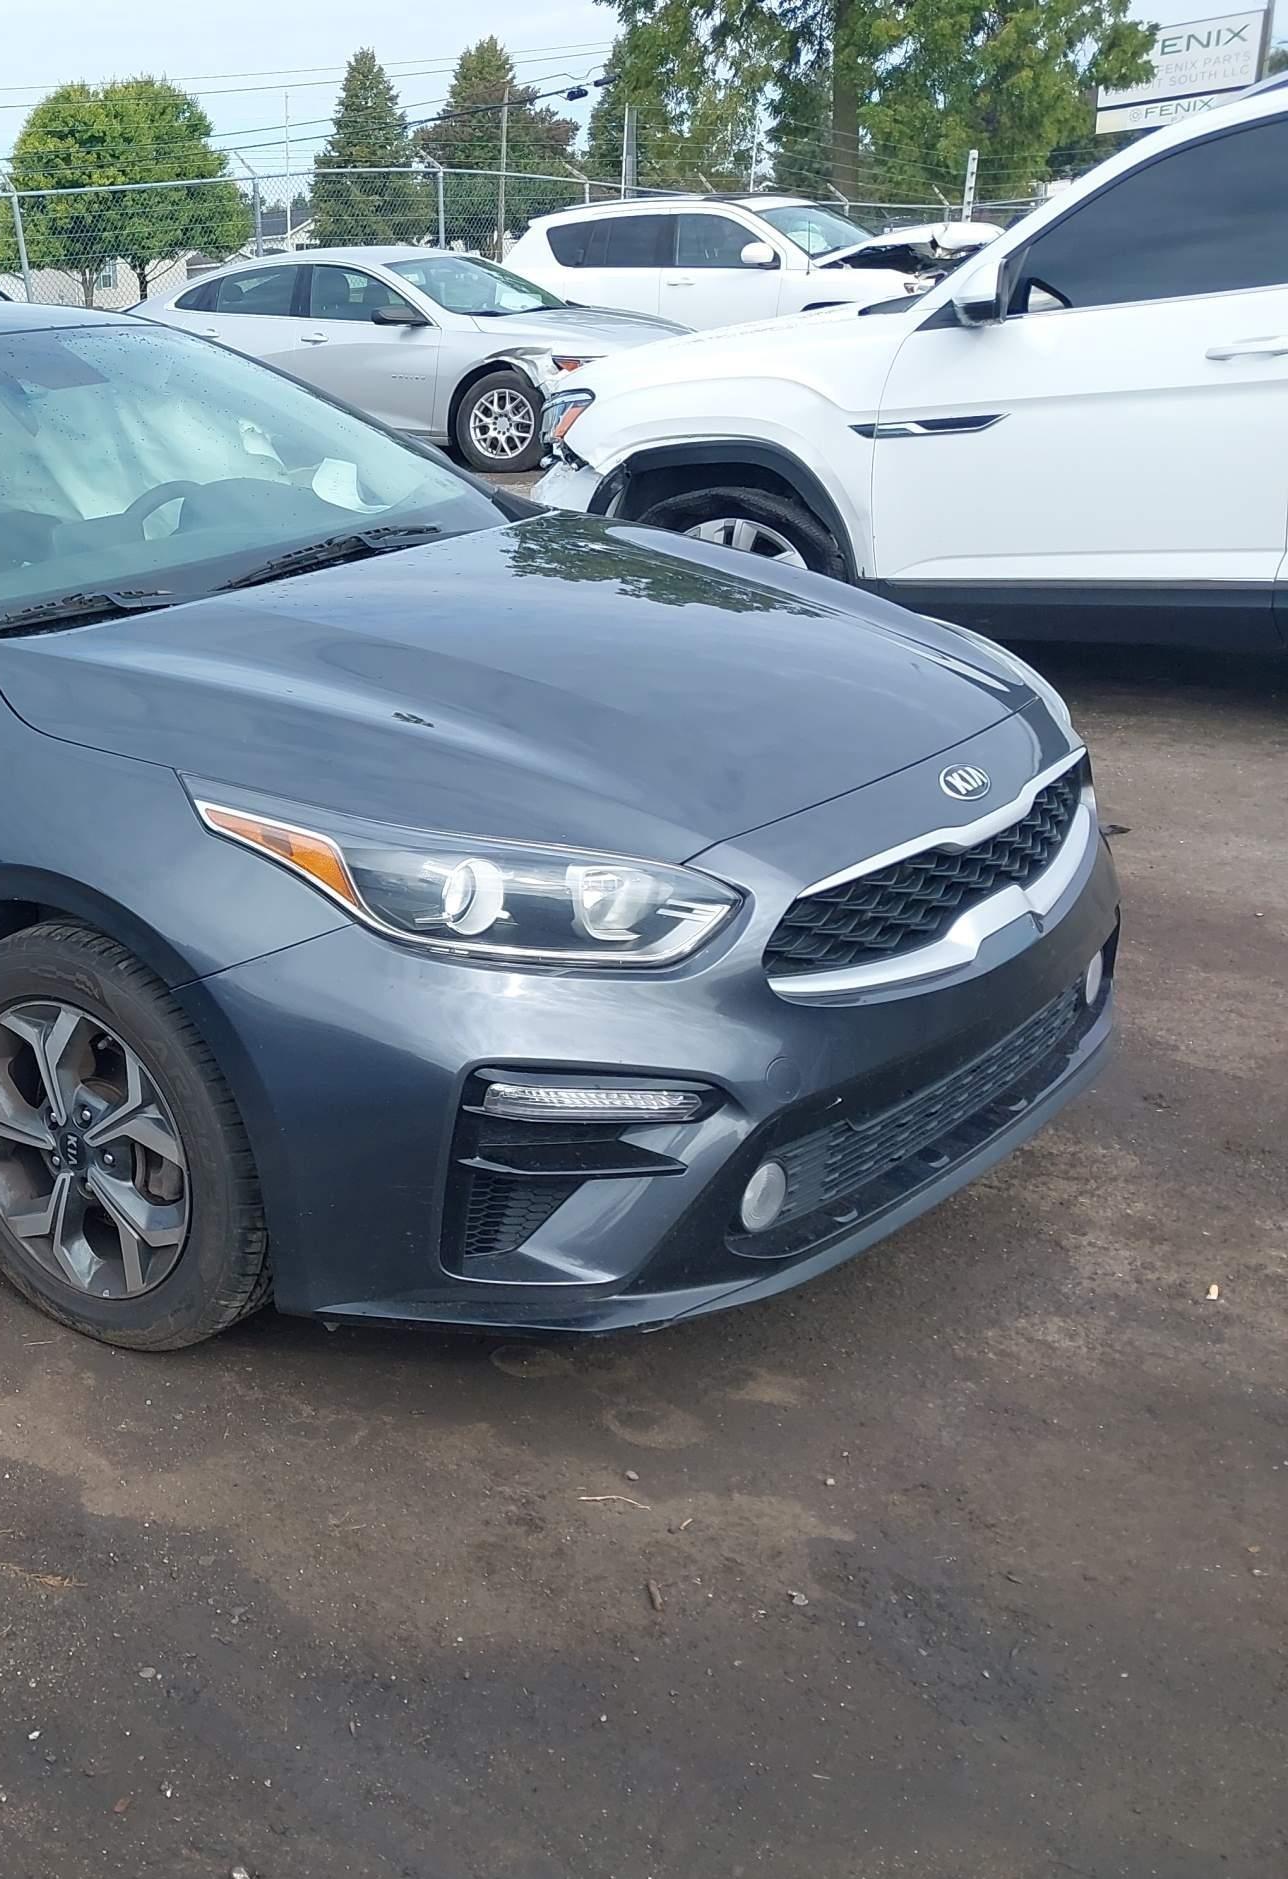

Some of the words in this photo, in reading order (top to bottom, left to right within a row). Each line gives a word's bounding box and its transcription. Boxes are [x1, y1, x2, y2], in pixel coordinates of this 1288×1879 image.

[1160, 24, 1250, 56] ENIX
[1203, 51, 1251, 68] PARTS
[1168, 69, 1217, 87] SOUTH
[1223, 64, 1249, 78] LLC
[1144, 97, 1215, 119] FENIX
[944, 766, 988, 795] KIA
[67, 1135, 78, 1165] KIA
